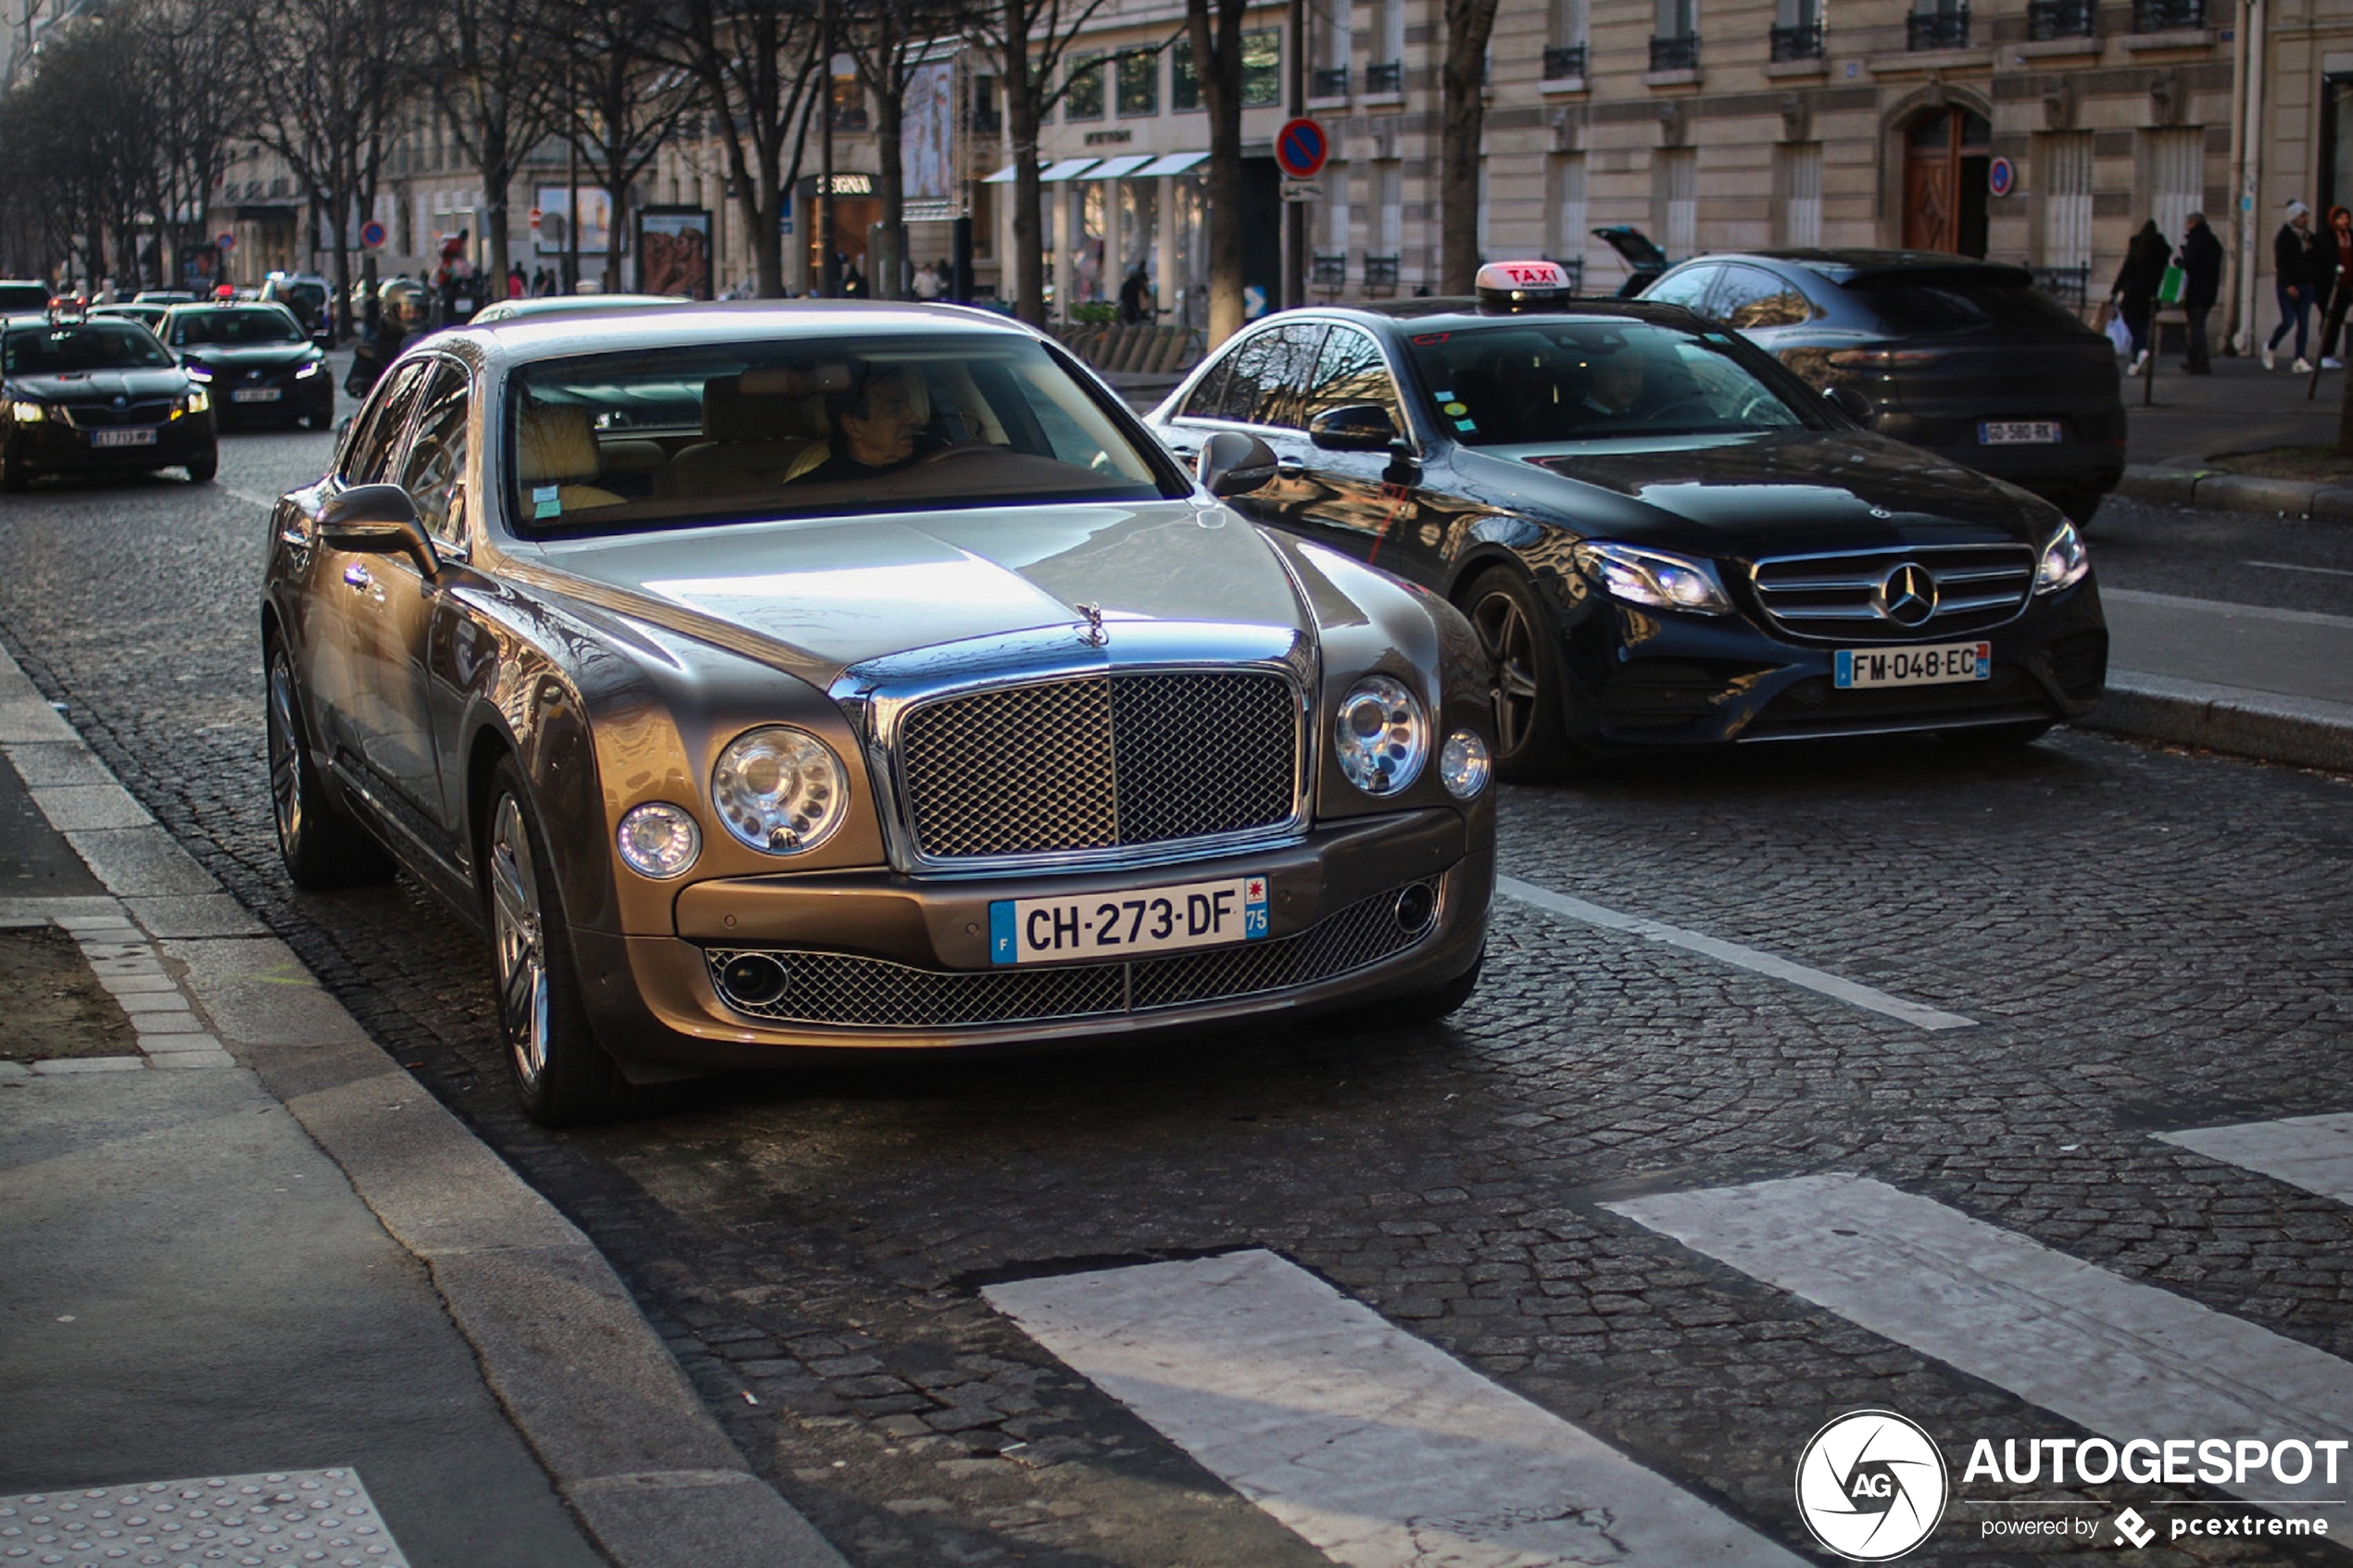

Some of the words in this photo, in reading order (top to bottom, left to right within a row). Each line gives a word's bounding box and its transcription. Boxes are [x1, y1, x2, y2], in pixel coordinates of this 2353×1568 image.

[1507, 270, 1558, 282] TAXI
[1413, 332, 1452, 345] G7
[1854, 648, 1975, 681] FM-048-EC
[999, 938, 1008, 951] F
[1026, 889, 1236, 951] CH-273-DF
[1246, 909, 1267, 931] 75
